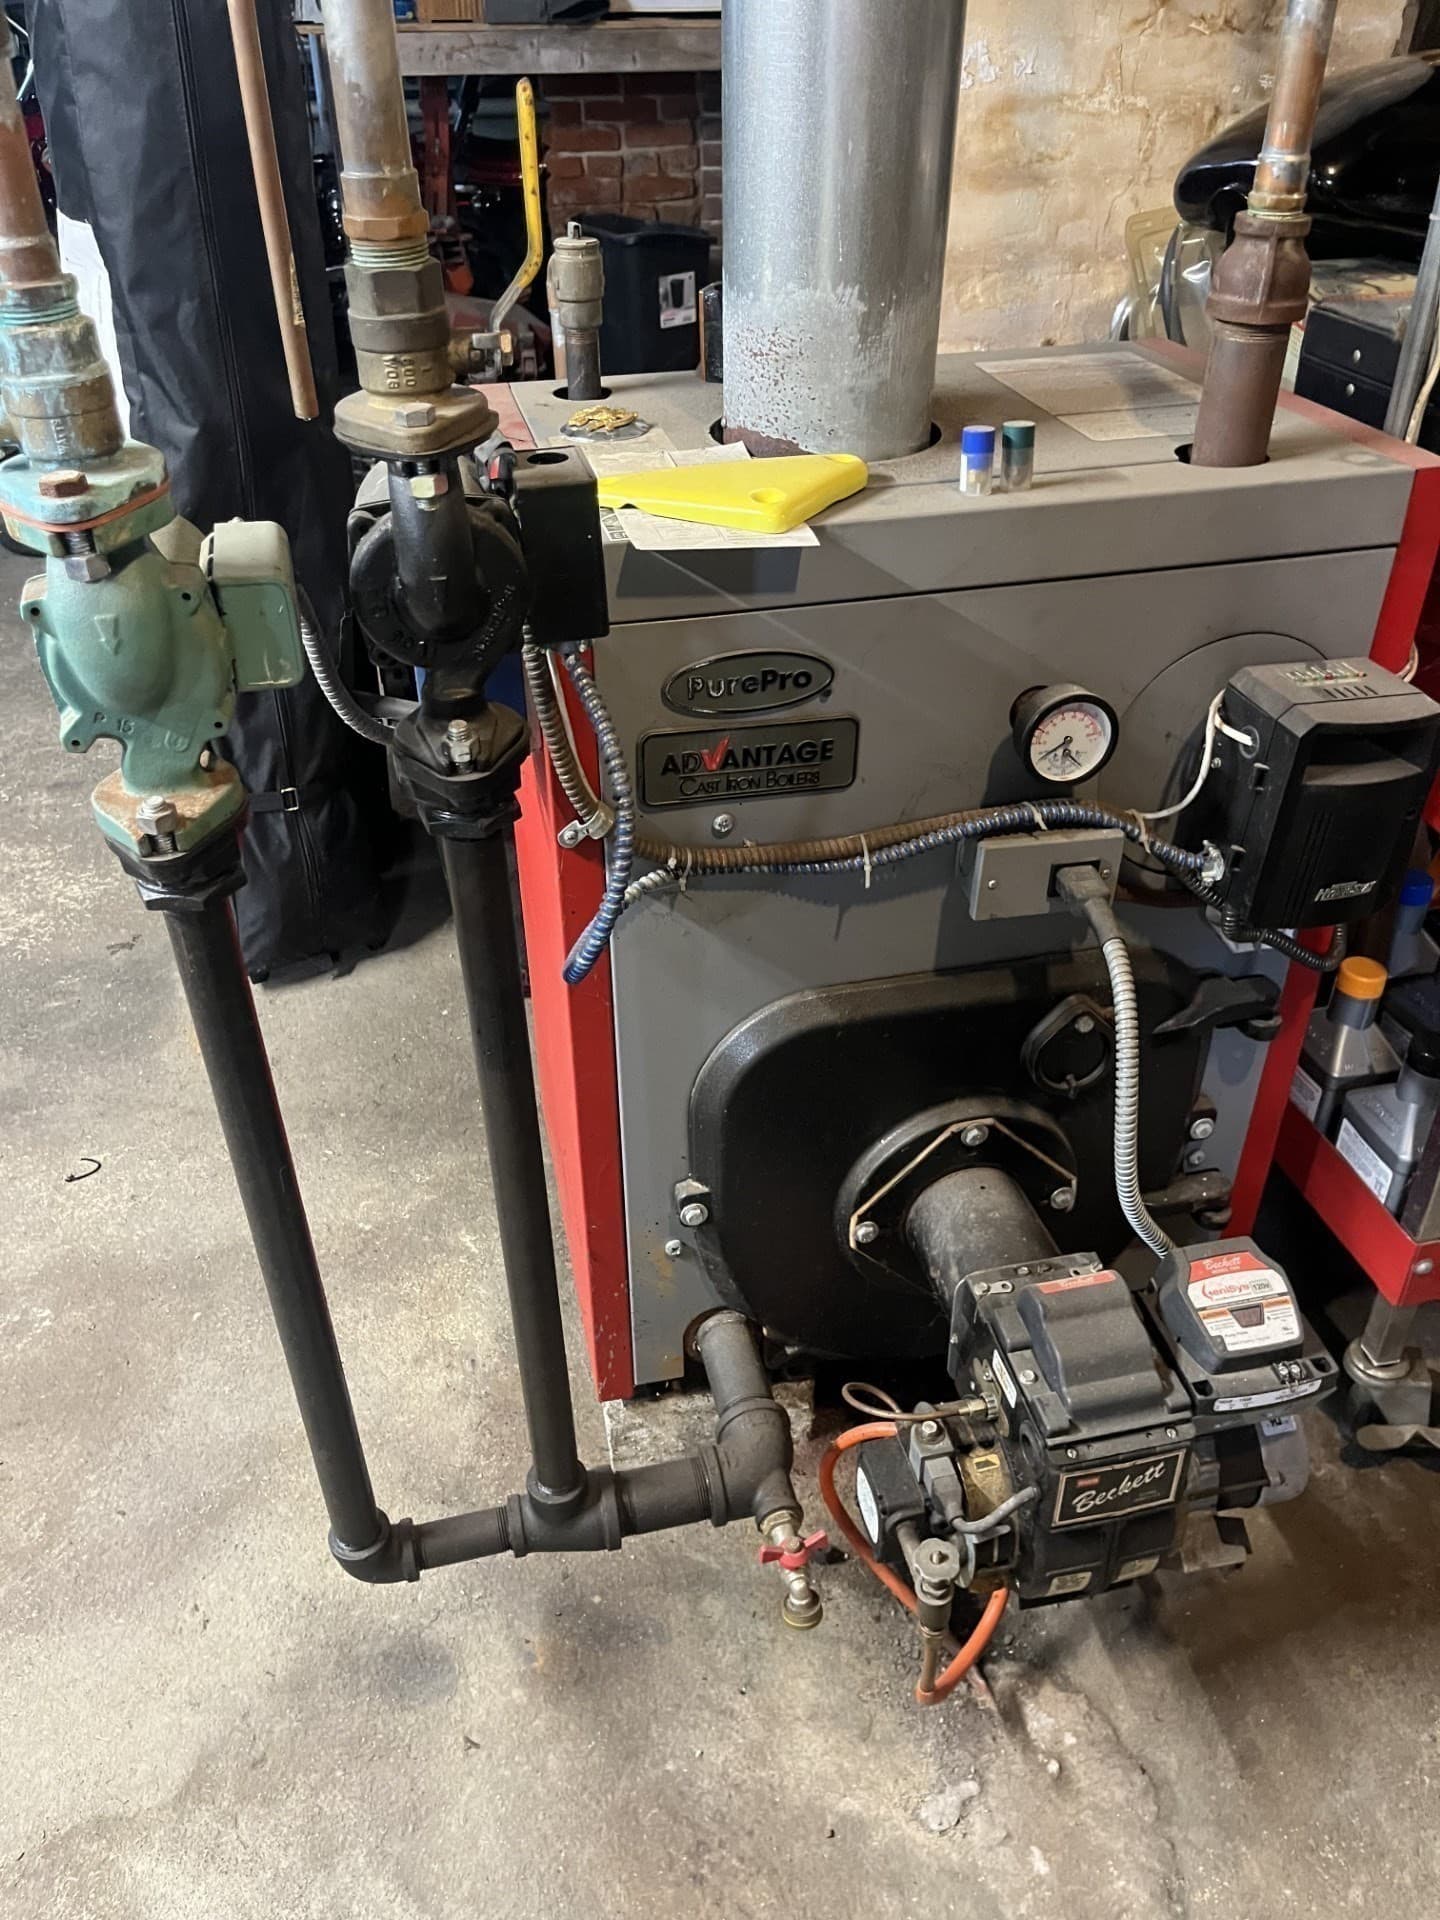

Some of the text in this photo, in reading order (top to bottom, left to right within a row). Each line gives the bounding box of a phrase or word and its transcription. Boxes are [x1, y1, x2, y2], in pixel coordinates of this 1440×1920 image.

[687, 668, 812, 700] PurePro
[661, 736, 835, 776] ADVANTAGE
[726, 774, 760, 793] IRON
[766, 769, 821, 788] BOILERS
[1072, 1461, 1166, 1513] Beckett
